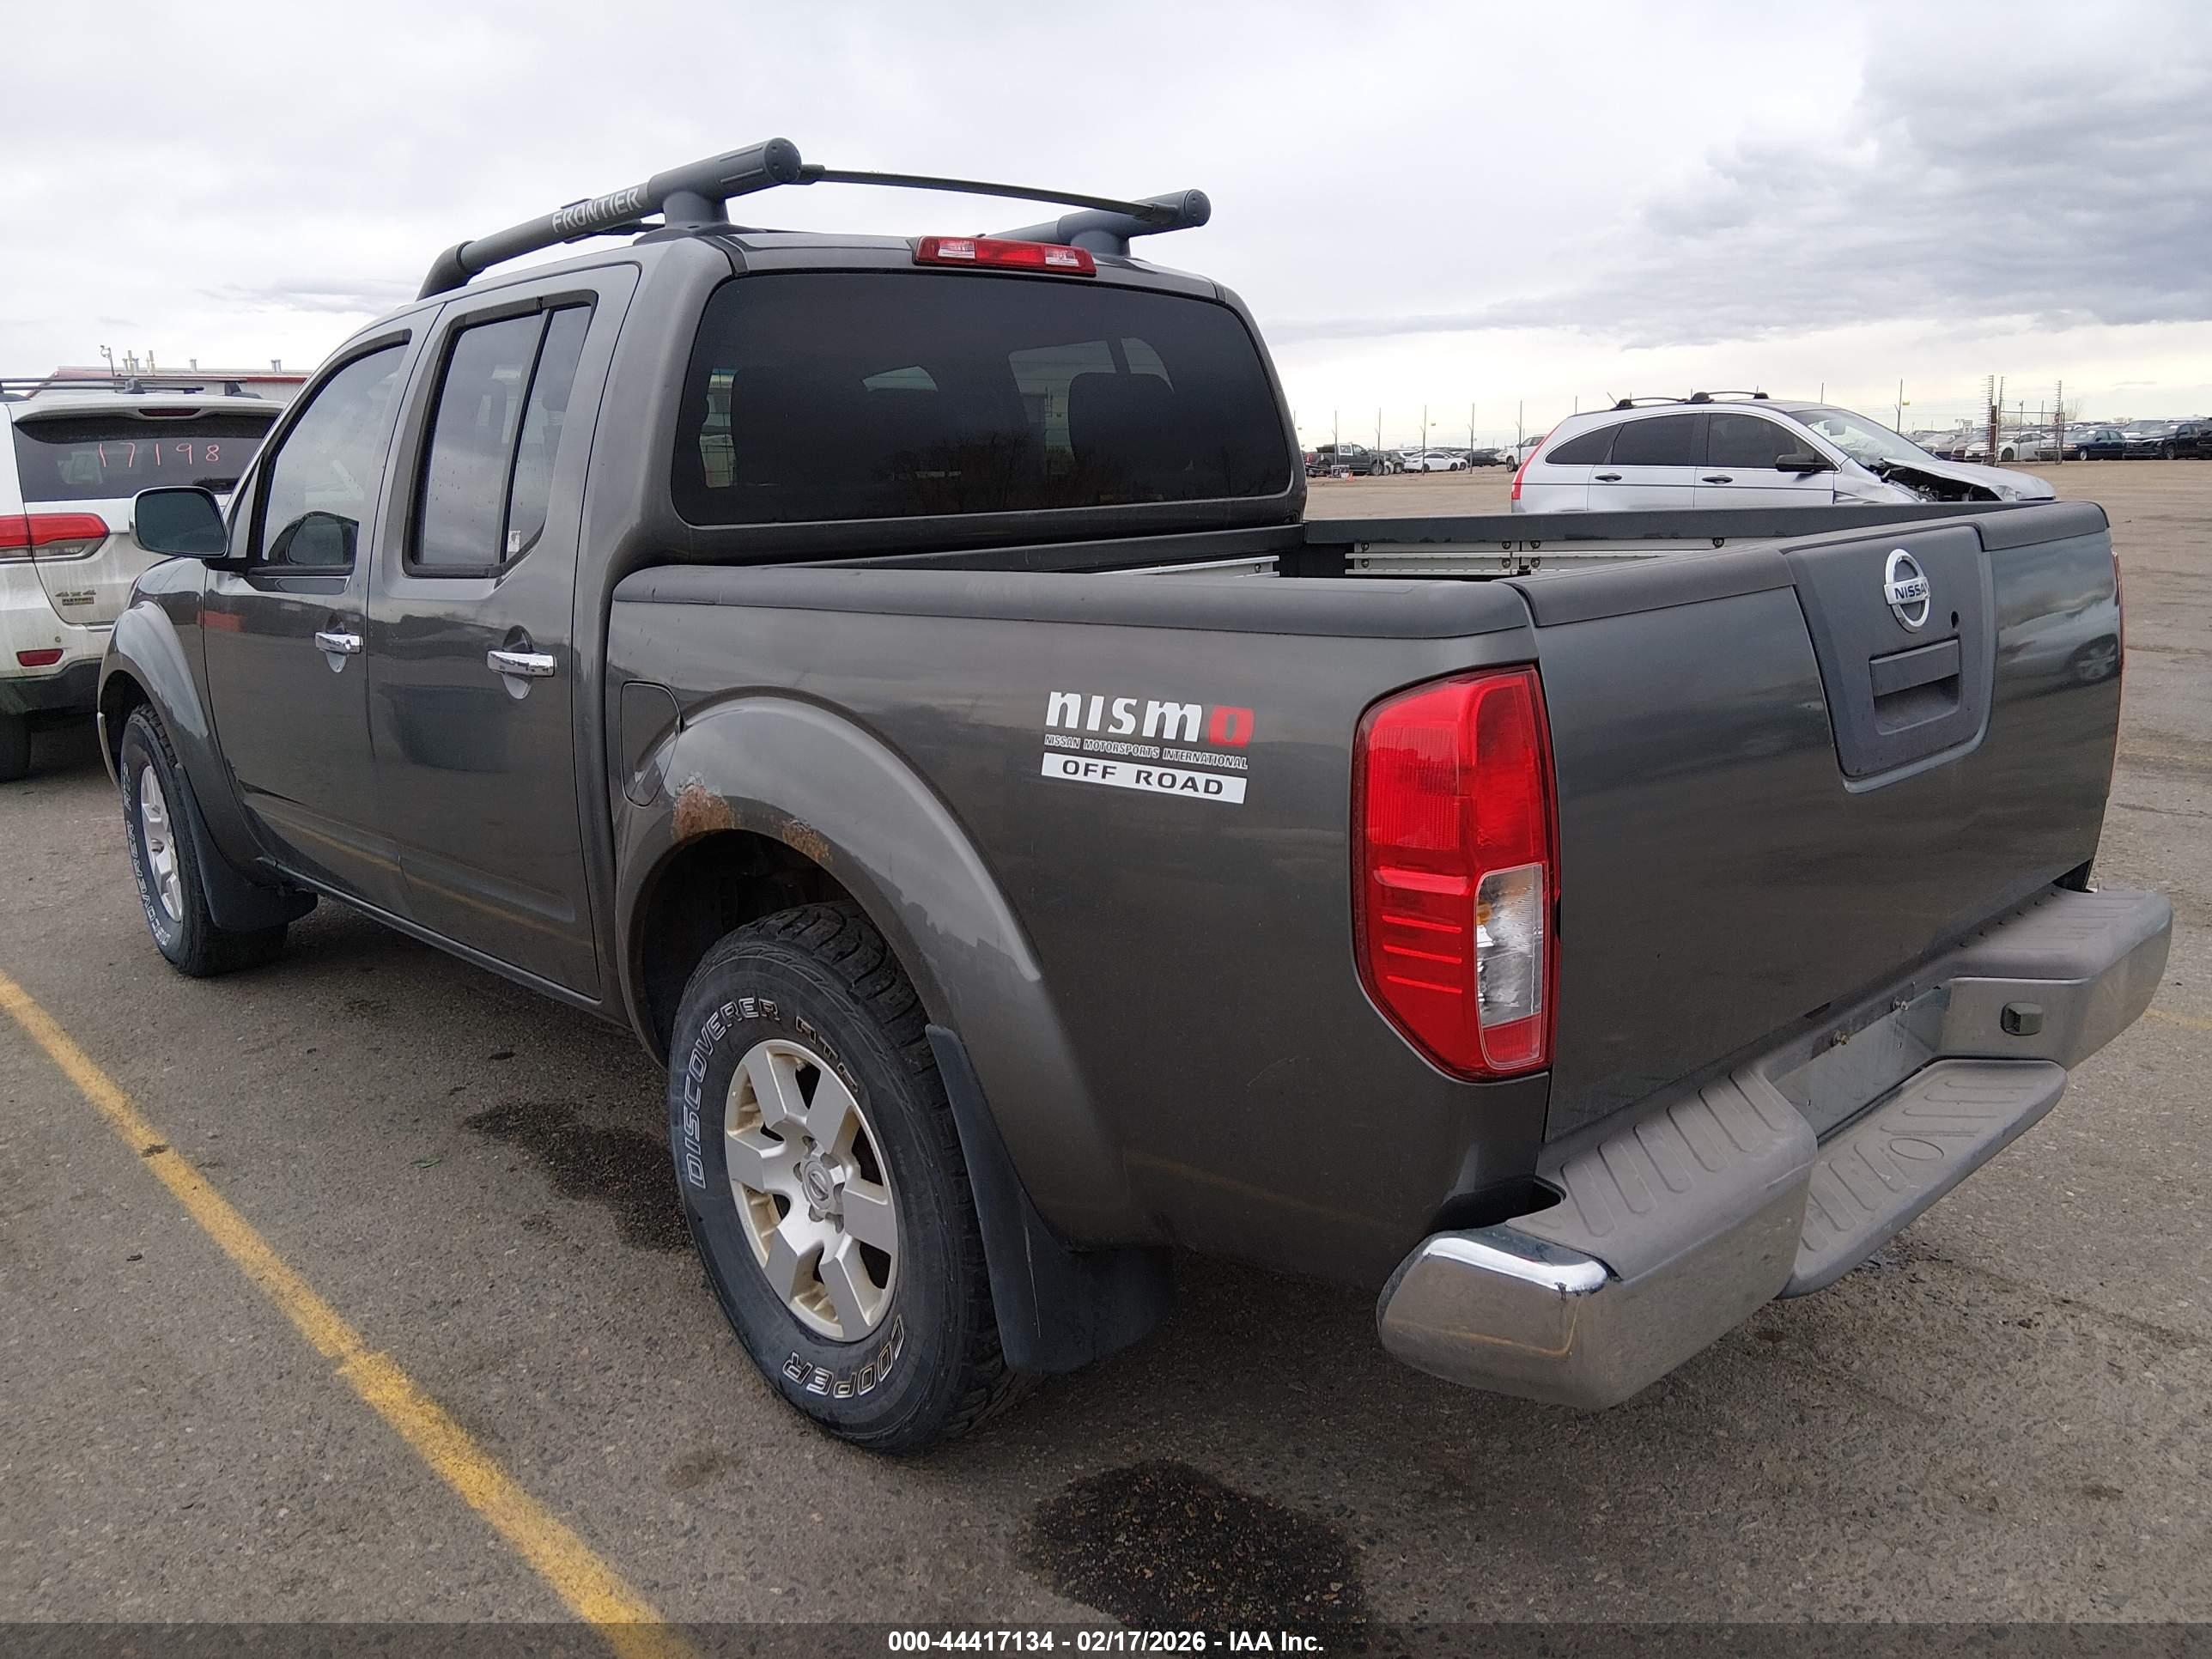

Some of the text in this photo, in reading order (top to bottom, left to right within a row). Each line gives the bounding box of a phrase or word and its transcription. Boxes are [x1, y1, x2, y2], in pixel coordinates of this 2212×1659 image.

[551, 187, 643, 234] FRONTIER
[98, 442, 220, 468] 17198
[1045, 690, 1255, 748] nismo
[1044, 734, 1249, 770] NISSAN MOTORSPORTS INTERNATIONAL
[1062, 760, 1224, 796] OFF ROAD
[684, 997, 781, 1189] DISCOVERER
[782, 1314, 904, 1399] COOPER
